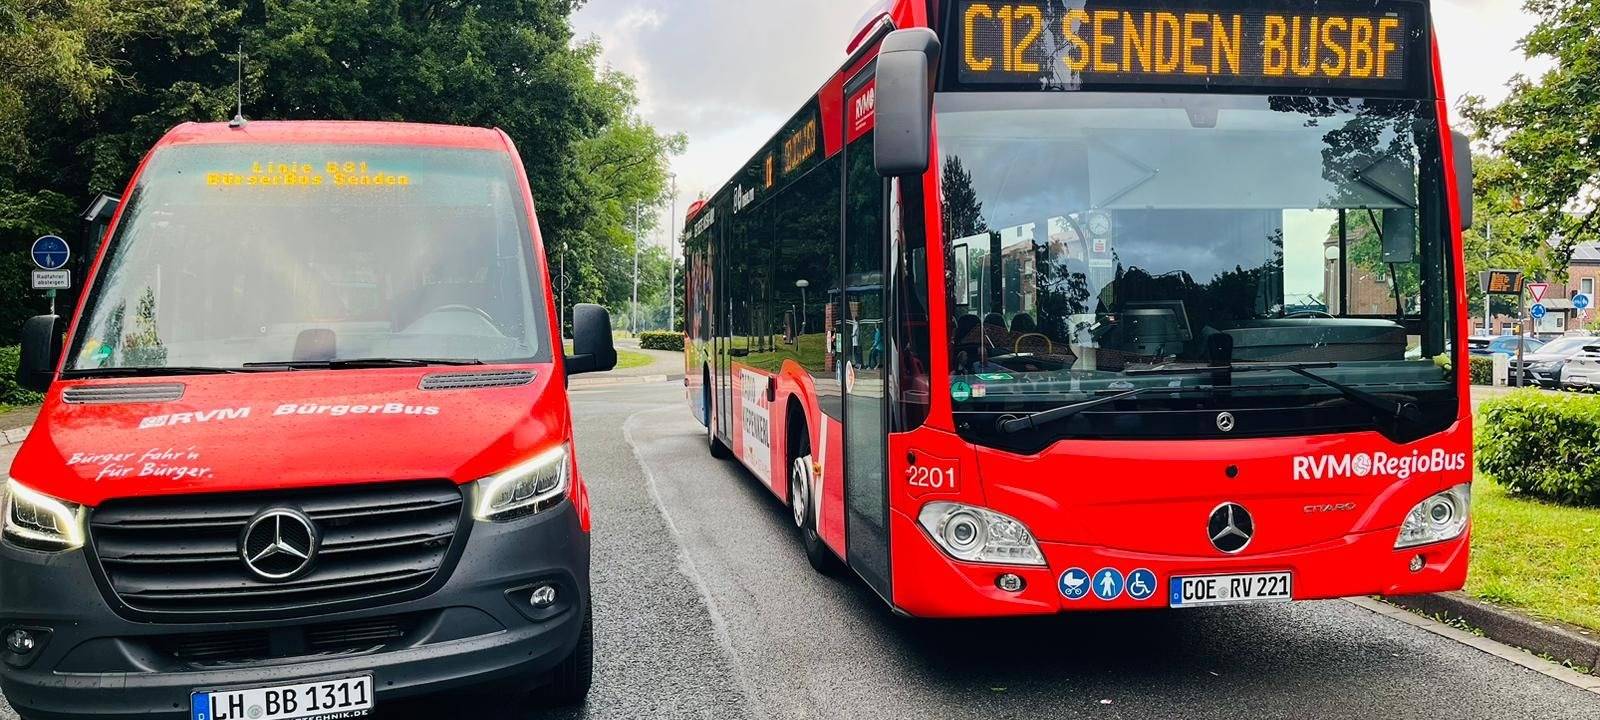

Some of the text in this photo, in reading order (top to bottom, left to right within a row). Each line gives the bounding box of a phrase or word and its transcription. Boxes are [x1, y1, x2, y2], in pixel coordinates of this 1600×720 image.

[964, 4, 1398, 79] C12 SENDEN BUSBF
[252, 160, 313, 174] Linie
[334, 171, 411, 187] Senden
[166, 402, 440, 427] RVM BürgerBus
[67, 451, 135, 466] Bürger
[1293, 448, 1465, 480] RVM RegioBus
[96, 461, 214, 482] für Bürger.
[909, 465, 955, 488] 2201
[1183, 580, 1217, 600] COE
[1230, 577, 1253, 598] RV
[1257, 575, 1289, 597] 221
[212, 694, 244, 720] LH
[266, 688, 298, 716] BB
[306, 681, 368, 712] 1311
